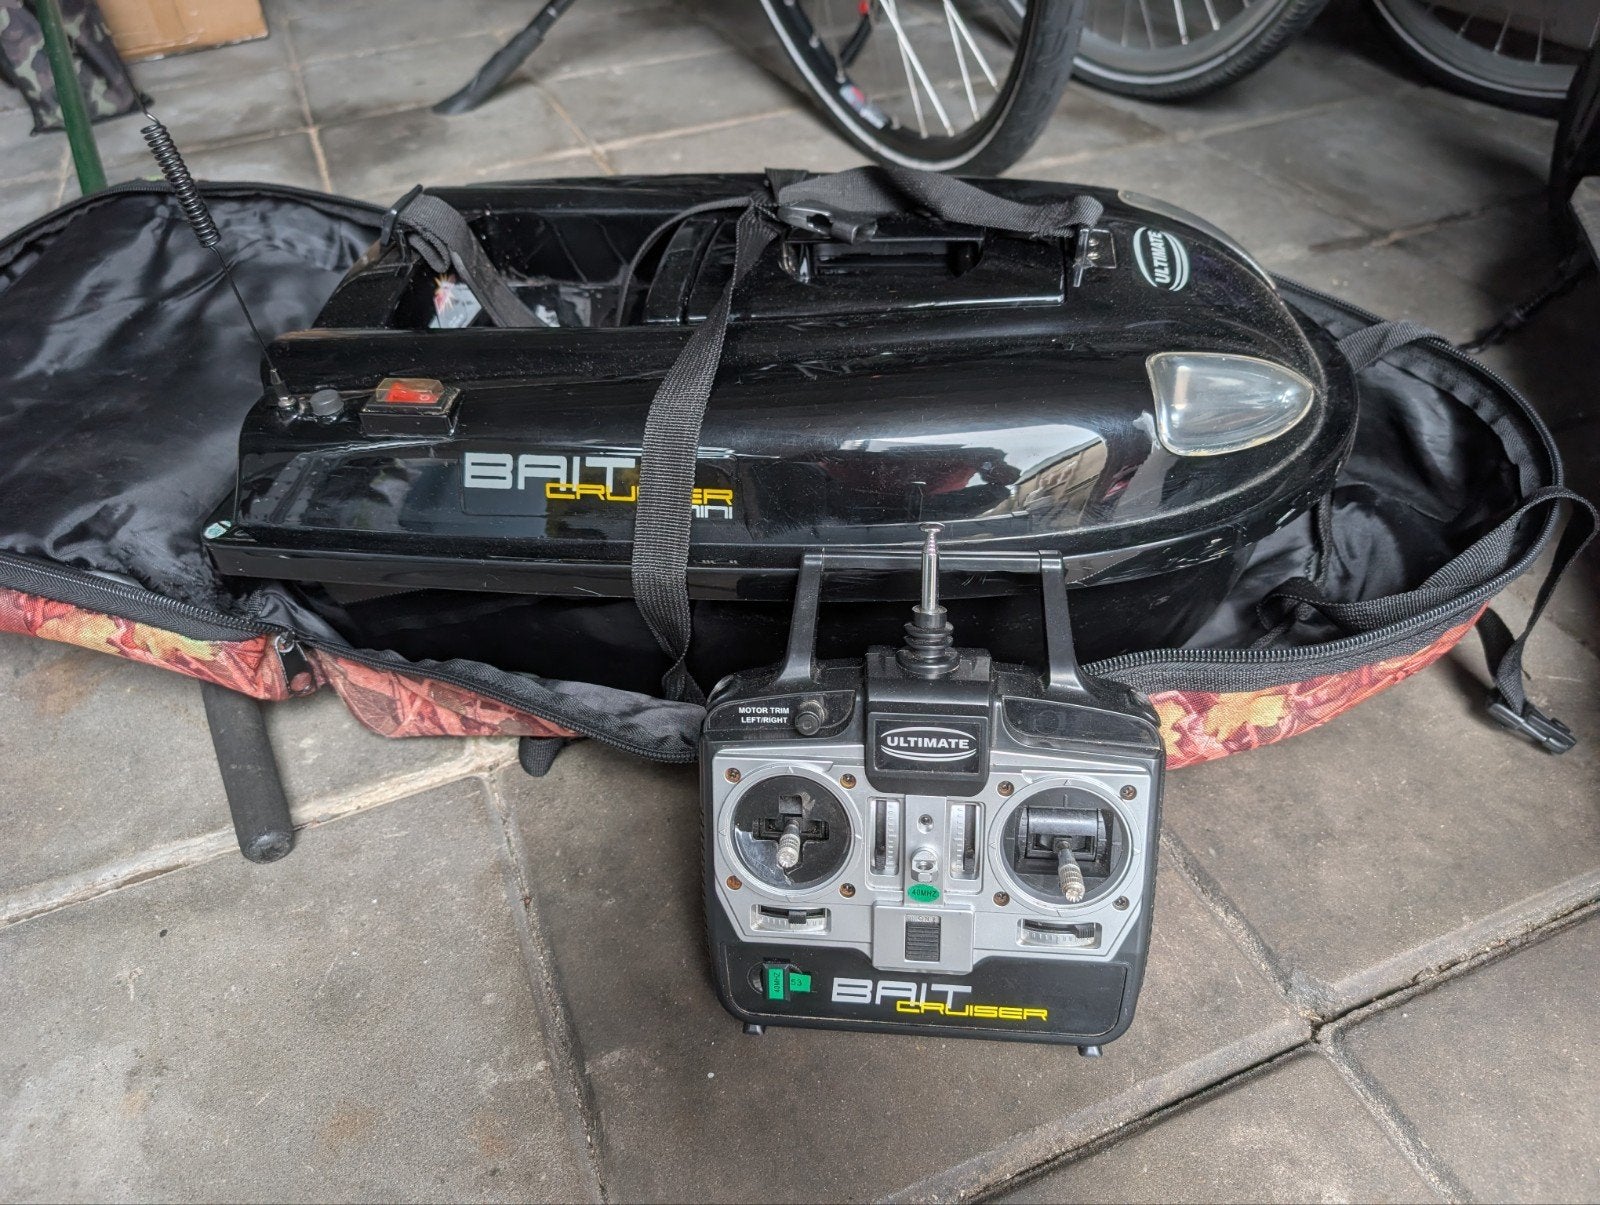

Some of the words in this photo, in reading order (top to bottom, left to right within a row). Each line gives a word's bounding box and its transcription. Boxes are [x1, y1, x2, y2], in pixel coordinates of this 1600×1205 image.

[1146, 230, 1171, 284] ULTIMATE
[464, 452, 636, 493] BAIT
[738, 706, 768, 714] MOTOR
[740, 716, 788, 724] LEFT/RIGHT
[886, 736, 970, 750] ULTIMATE
[831, 977, 972, 1009] BAIT
[896, 1000, 1048, 1022] CRUISER
